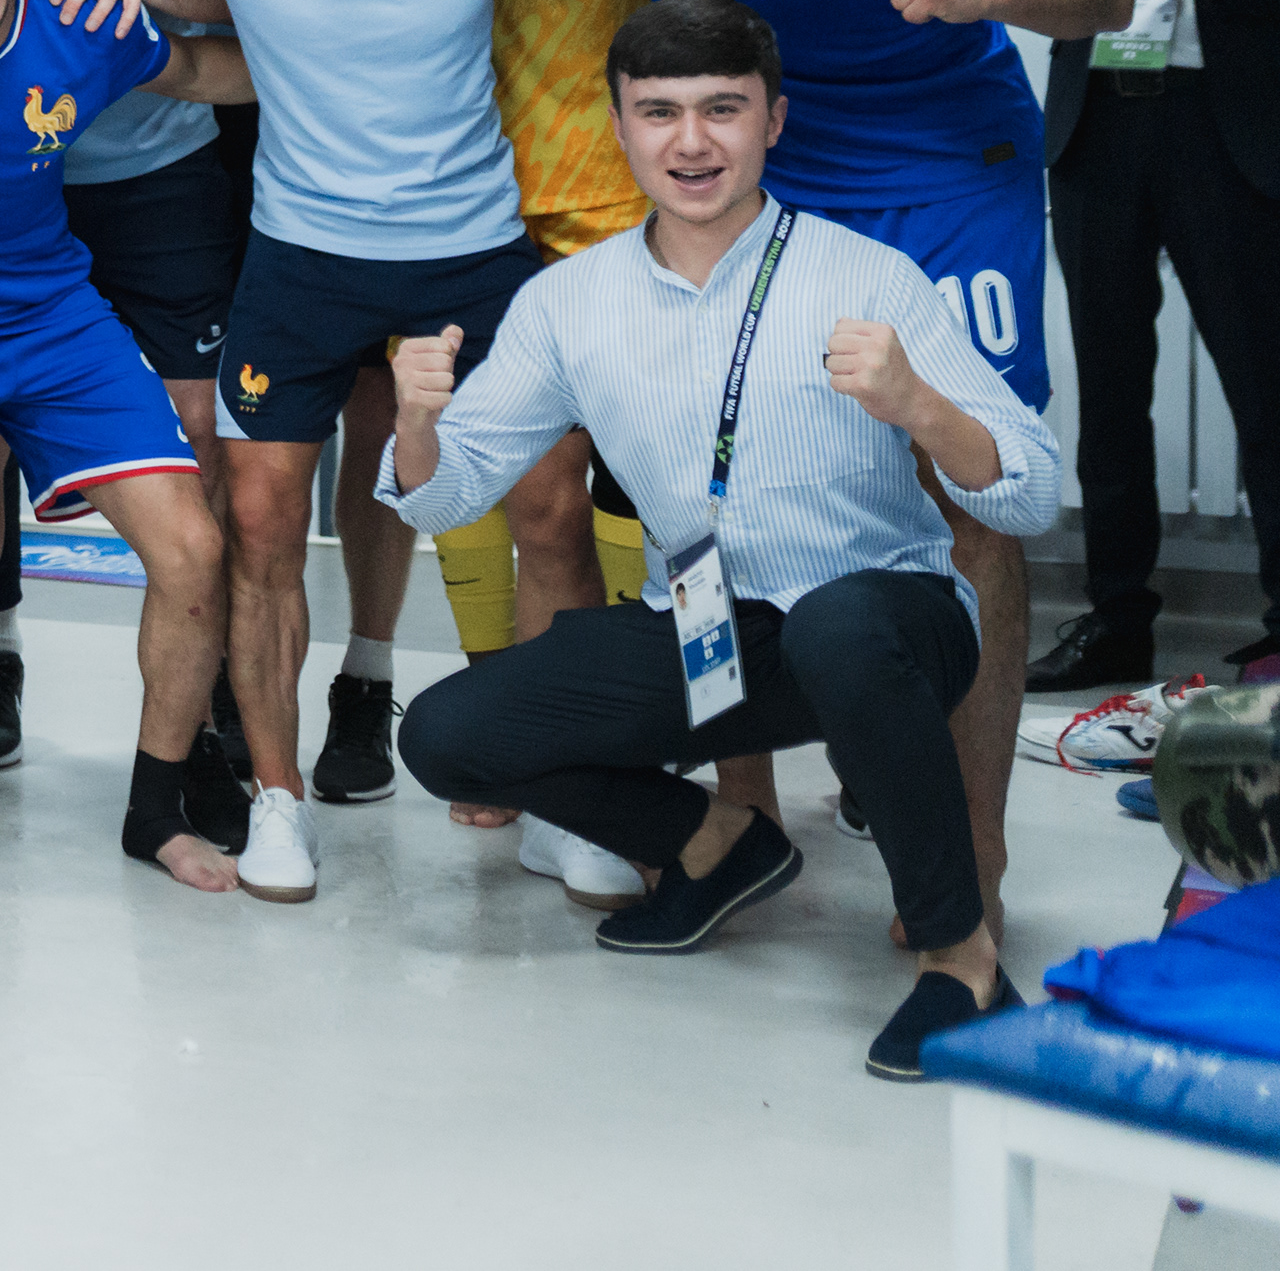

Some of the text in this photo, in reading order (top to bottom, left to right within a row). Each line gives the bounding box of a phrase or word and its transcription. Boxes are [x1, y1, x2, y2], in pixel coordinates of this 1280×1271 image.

[724, 213, 792, 421] FIFA FUTSAL WORLD CUP UZBEKISTAN 2024
